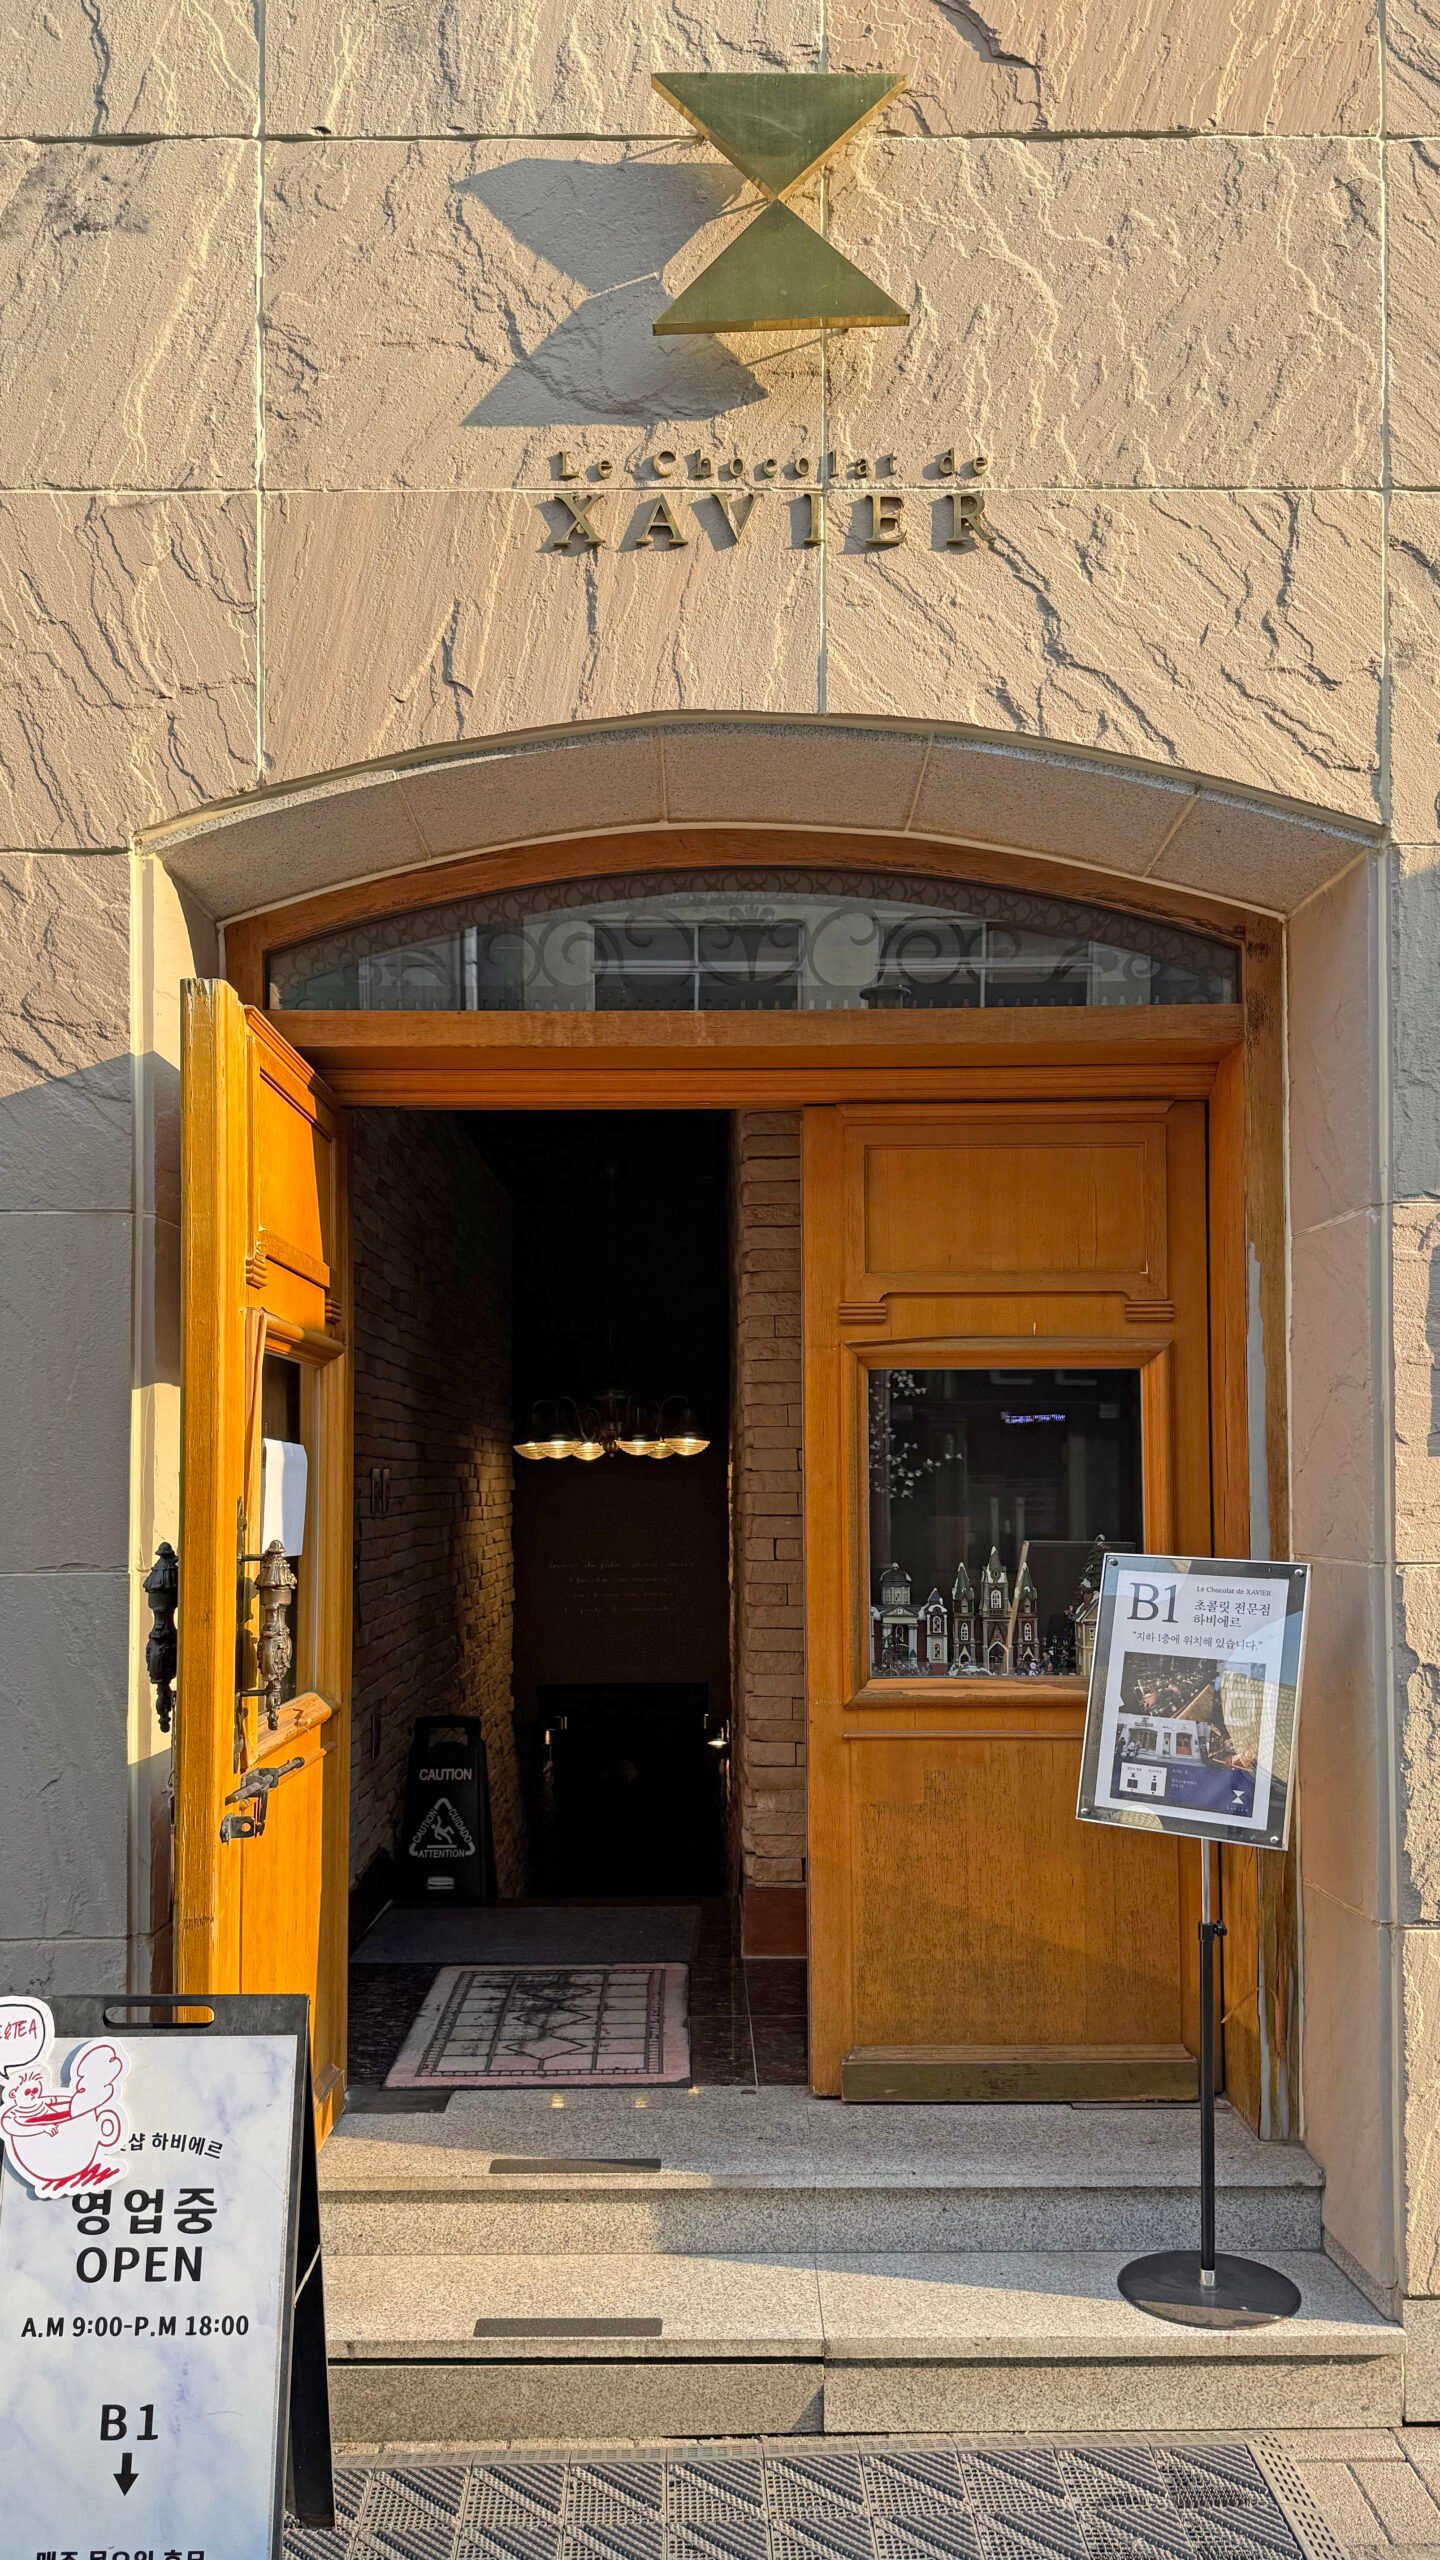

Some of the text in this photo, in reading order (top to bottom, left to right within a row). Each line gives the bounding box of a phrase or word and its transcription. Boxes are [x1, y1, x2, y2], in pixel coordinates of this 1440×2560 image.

[560, 447, 989, 479] Le Chocolat de
[553, 493, 997, 547] XAVIER
[1127, 1582, 1179, 1624] B1
[1206, 1586, 1234, 1595] Chocolat
[1246, 1588, 1271, 1597] XAVIER
[1193, 1613, 1242, 1628] 하비에르
[1194, 1600, 1271, 1617] 초콜릿 전문점
[1183, 1635, 1213, 1648] 위치해
[419, 1768, 472, 1781] CAUTION
[412, 1808, 438, 1844] CAUTION
[449, 1808, 473, 1844] CUIDADO
[418, 1849, 465, 1858] ATTENTION
[152, 2132, 223, 2160] 하비에르
[72, 2187, 218, 2236] 영업중
[76, 2246, 203, 2284] OPEN
[20, 2315, 249, 2338] A.M 9:00-P.M 18:00
[100, 2403, 159, 2442] B1
